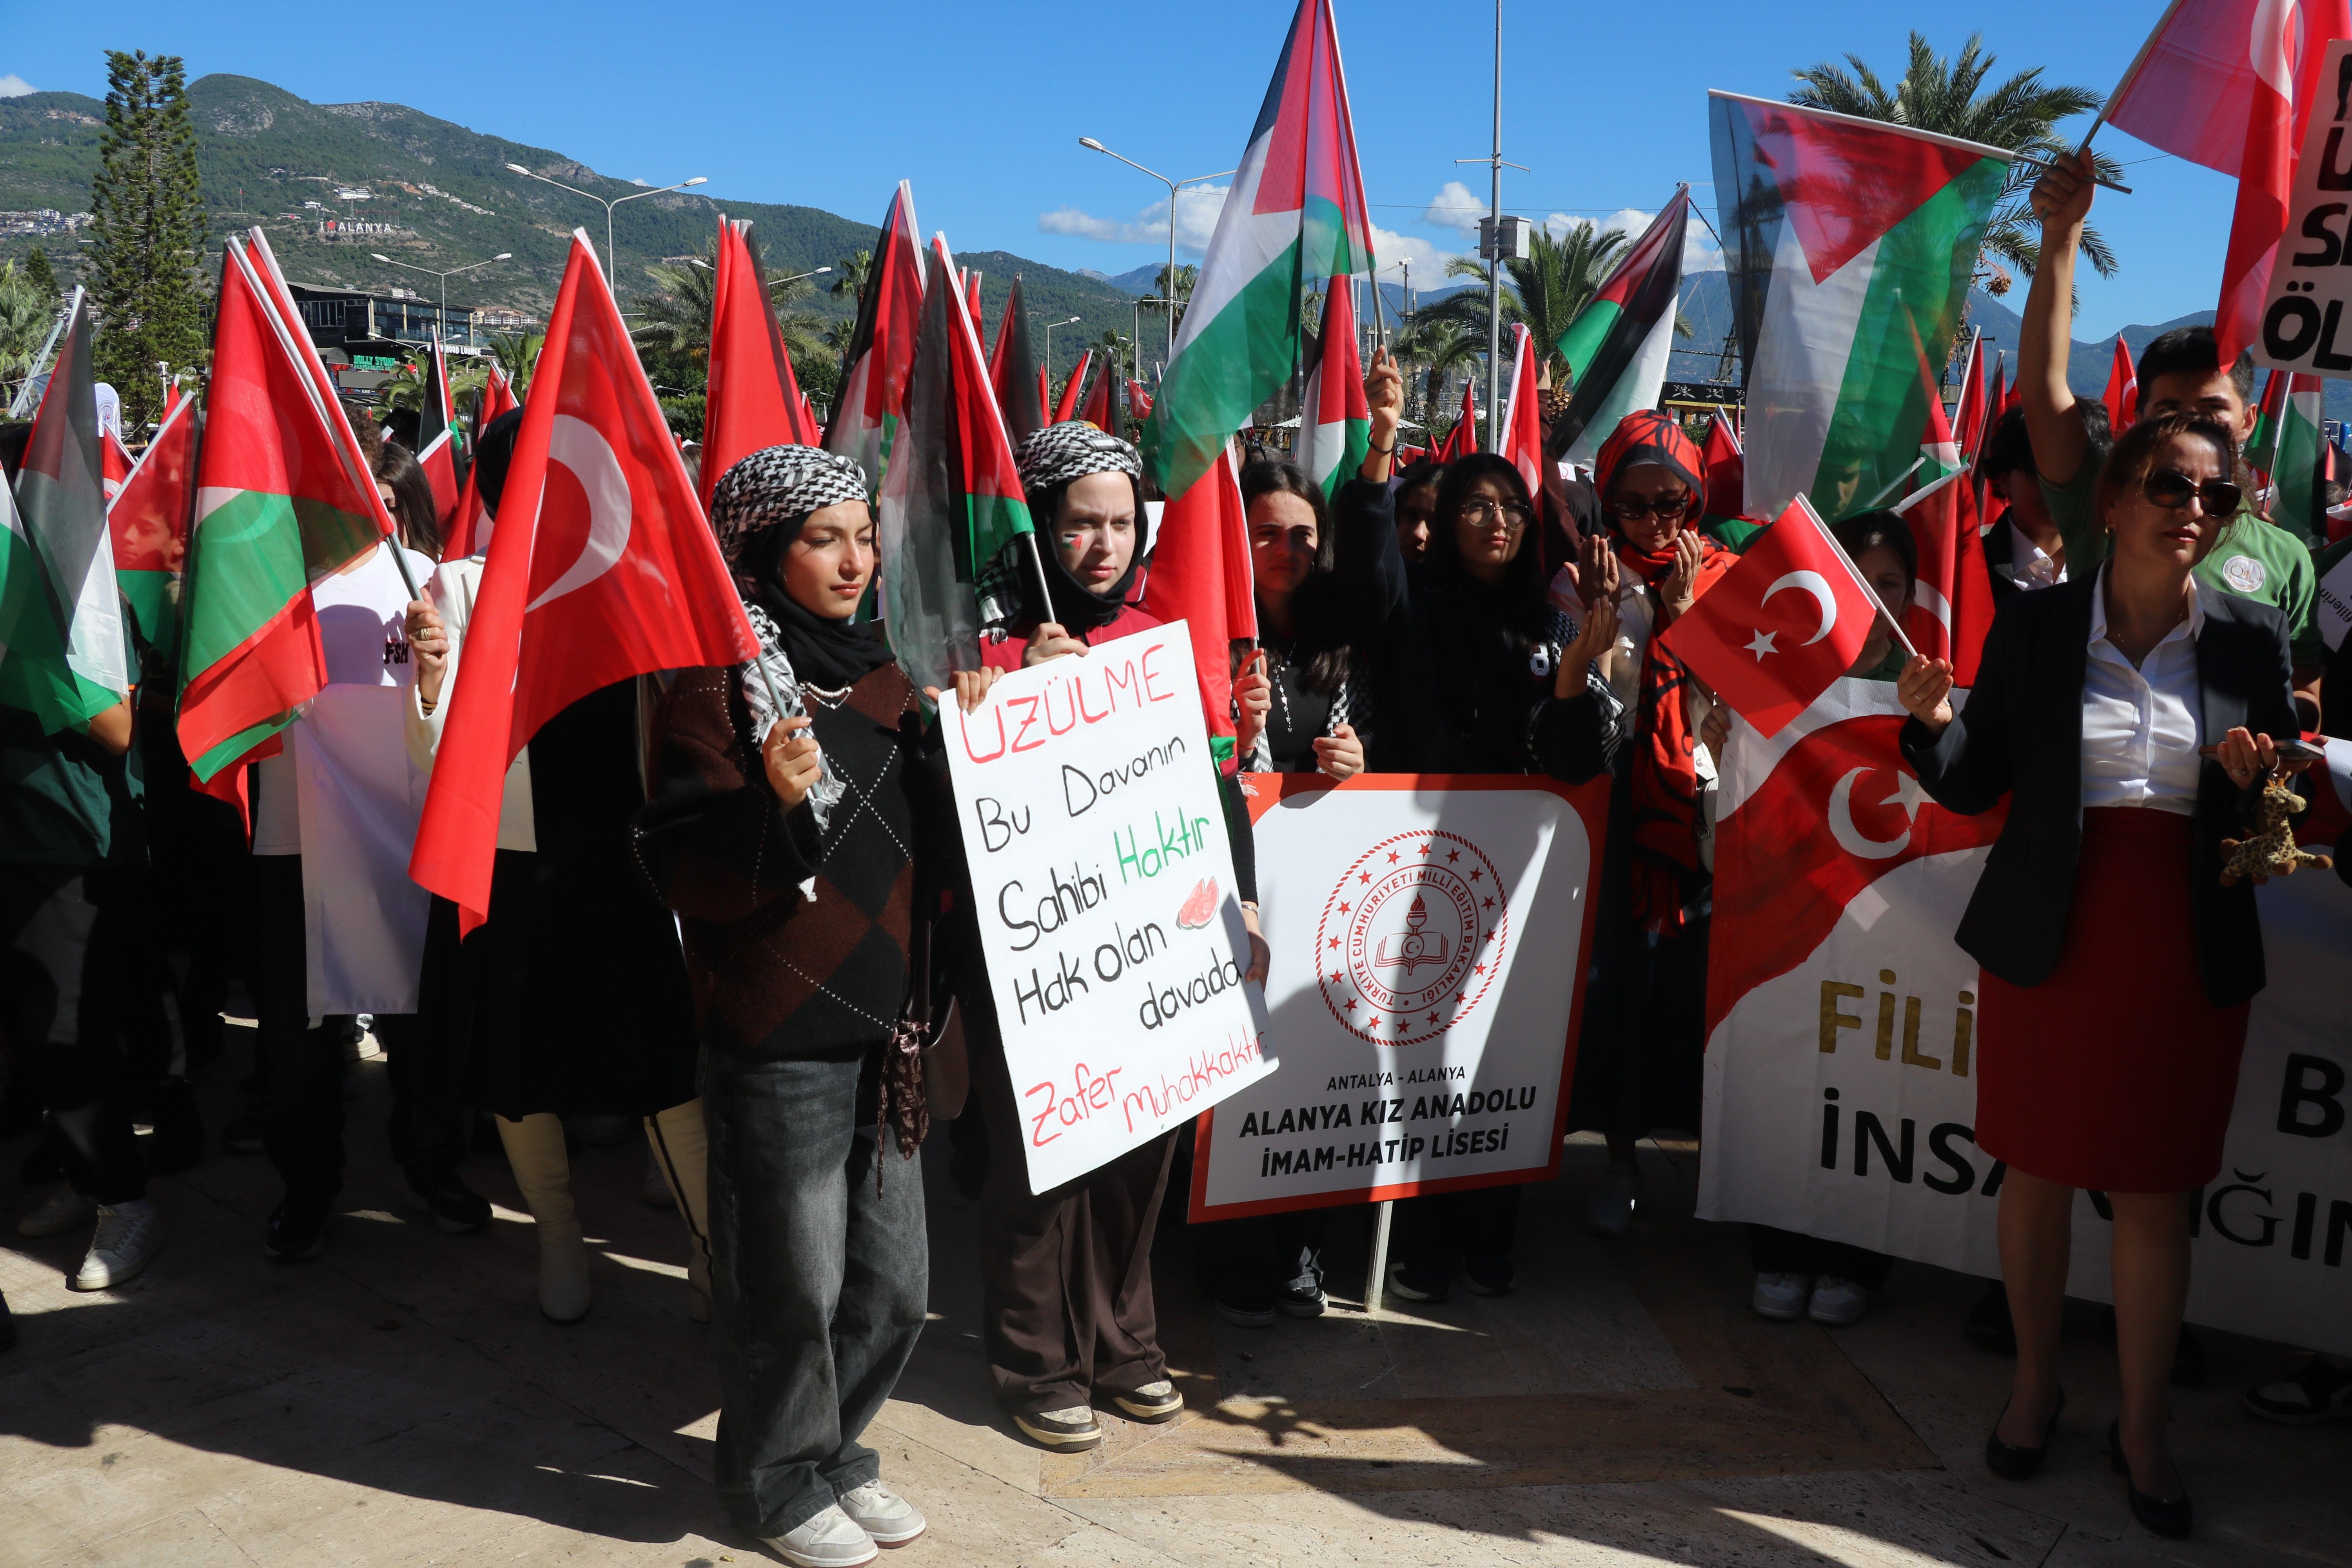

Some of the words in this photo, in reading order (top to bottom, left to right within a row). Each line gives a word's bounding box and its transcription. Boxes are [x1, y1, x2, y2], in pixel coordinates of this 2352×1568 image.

[338, 222, 392, 232] ALANYA
[2292, 202, 2352, 267] S
[461, 347, 481, 357] LOUNGE
[384, 642, 410, 664] FSM
[976, 797, 1031, 853] Bu
[1062, 736, 1185, 817] Davanın
[998, 861, 1107, 951] Sahibi
[1114, 806, 1210, 886] Haktır
[1417, 868, 1454, 889] MİLLÎ
[1450, 886, 1476, 931] EĞİTİM
[1352, 869, 1413, 957] CUMHURİYETİ
[1014, 951, 1089, 1026] Hak
[1140, 947, 1242, 1029] davada
[1354, 960, 1394, 1005] TÜRKİYE
[1421, 935, 1473, 1004] BAKANLIĞI
[1819, 969, 1975, 1078] FİLİ
[1024, 1063, 1122, 1147] Zafer
[1326, 1072, 1393, 1091] ANTALYA
[1407, 1066, 1466, 1084] ALANYA
[1239, 1103, 1352, 1138] ALANYA
[1360, 1098, 1405, 1126] KIZ
[1410, 1085, 1537, 1121] ANADOLU
[1261, 1133, 1425, 1177] İMAM-HATİP
[1431, 1122, 1509, 1158] LİSESİ
